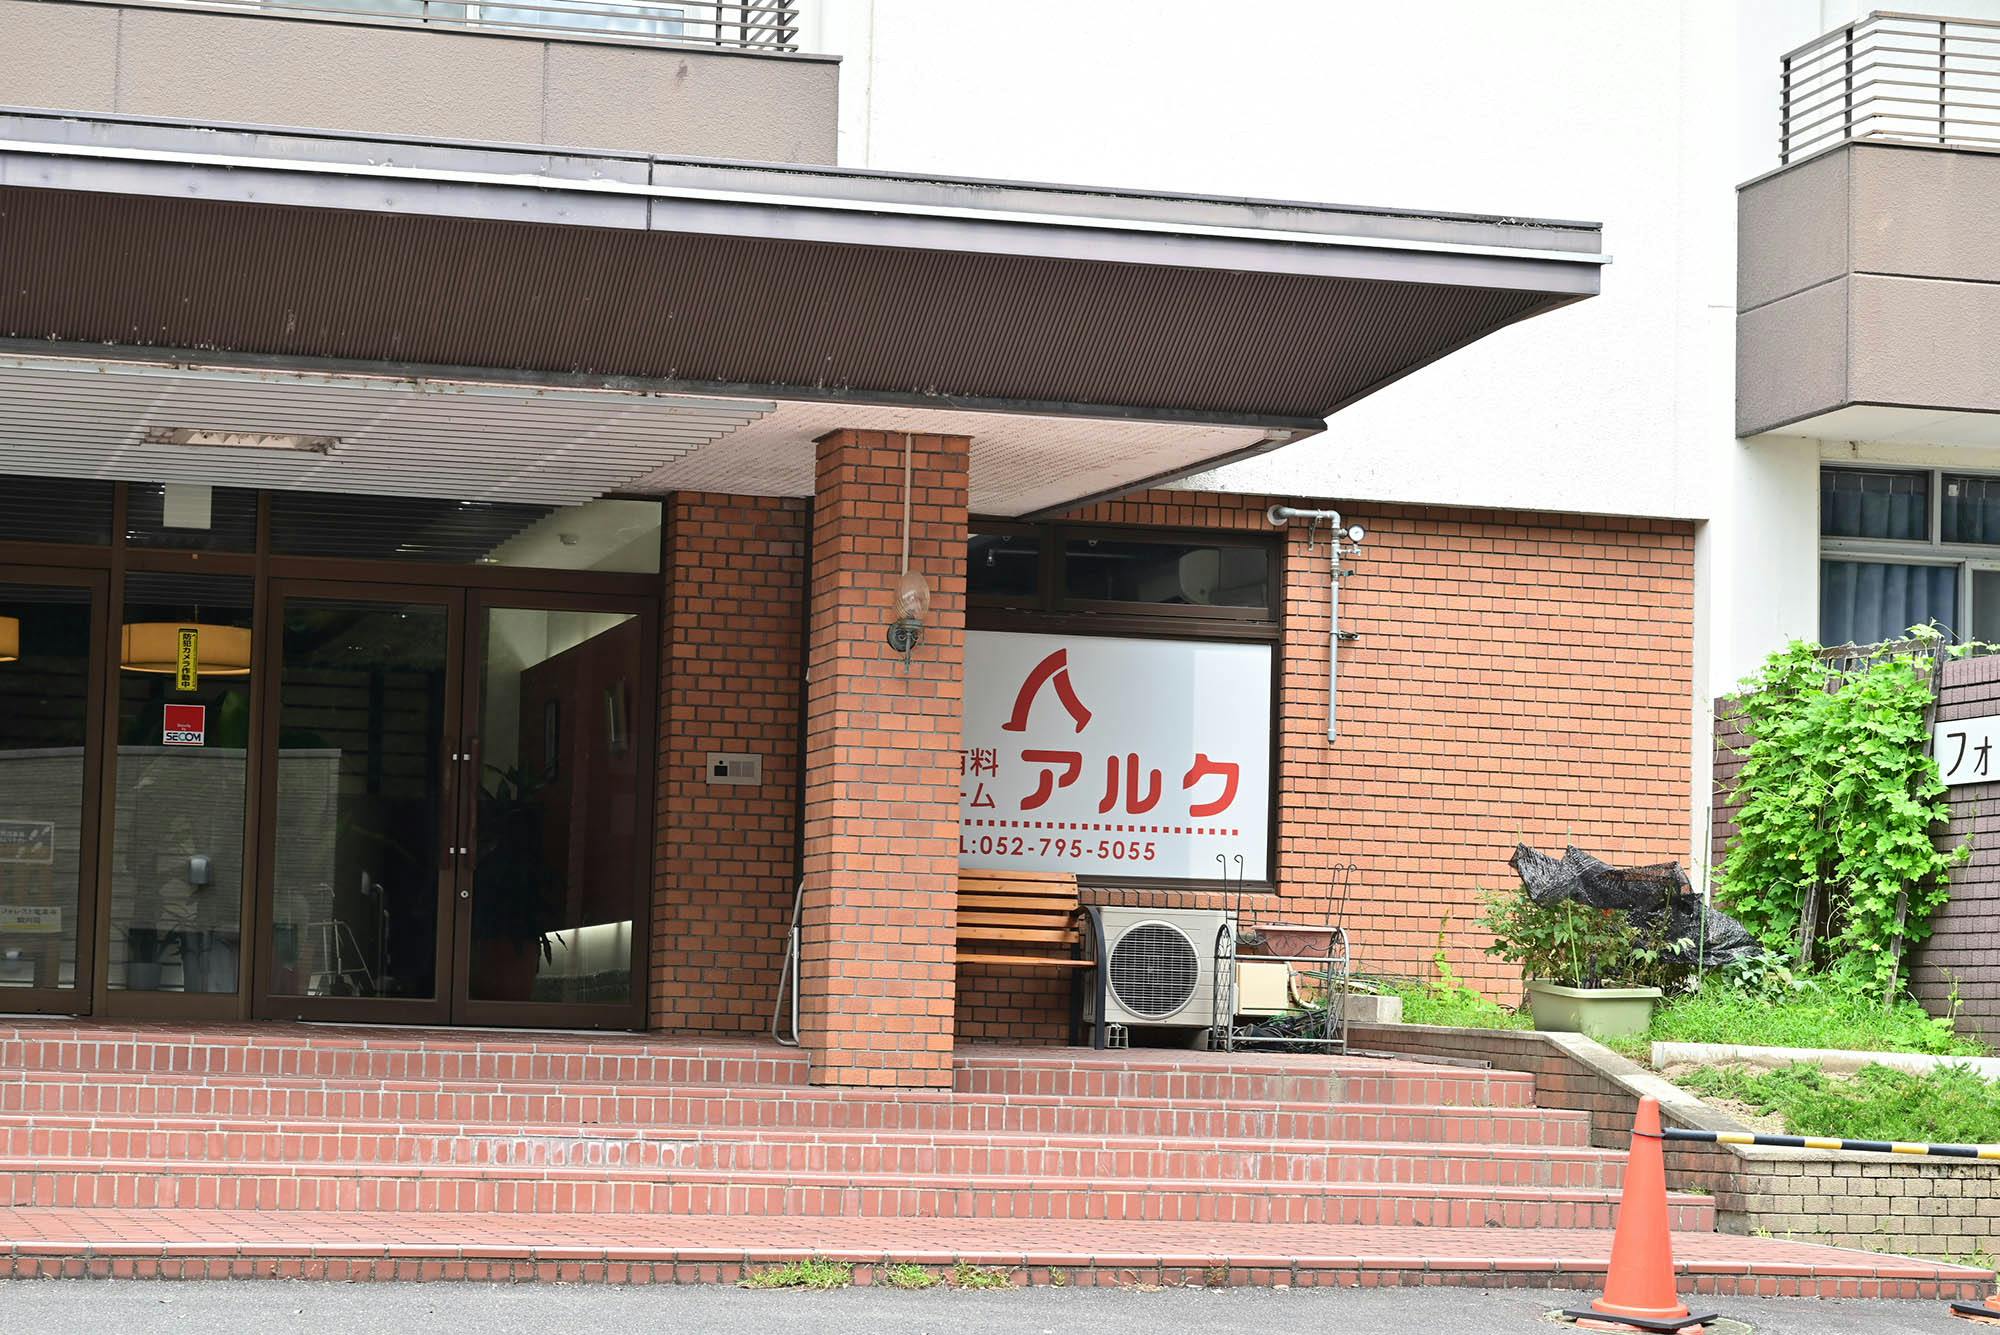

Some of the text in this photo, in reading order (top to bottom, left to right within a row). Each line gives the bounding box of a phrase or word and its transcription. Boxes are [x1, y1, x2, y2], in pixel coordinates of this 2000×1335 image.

[166, 732, 201, 742] SECOM
[1946, 732, 1993, 776] フォ
[1020, 749, 1240, 818] アルク
